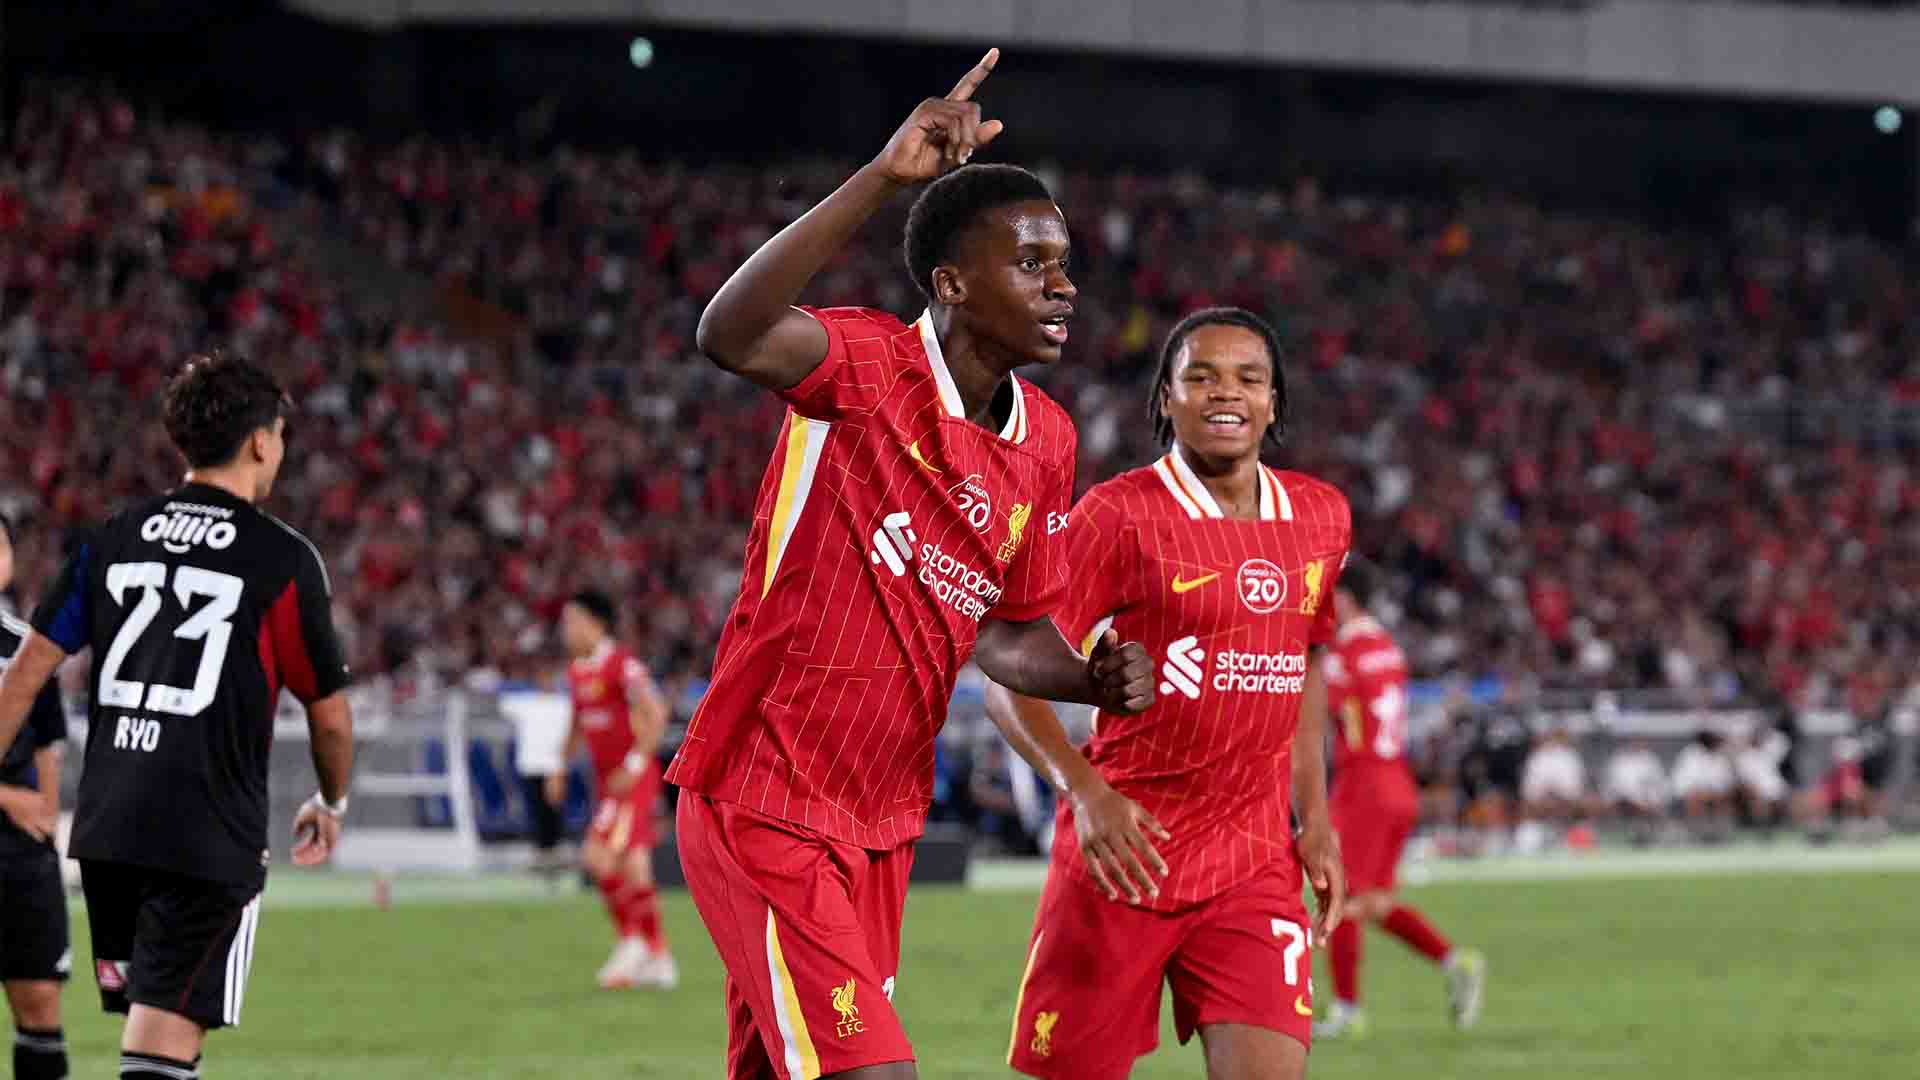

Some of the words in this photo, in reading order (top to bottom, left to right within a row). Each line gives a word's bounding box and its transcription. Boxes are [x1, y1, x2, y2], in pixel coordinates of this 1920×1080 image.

[957, 492, 989, 529] 20
[1245, 577, 1280, 603] 20
[99, 561, 244, 717] 23
[114, 716, 160, 752] RYO
[1270, 917, 1312, 996] 7
